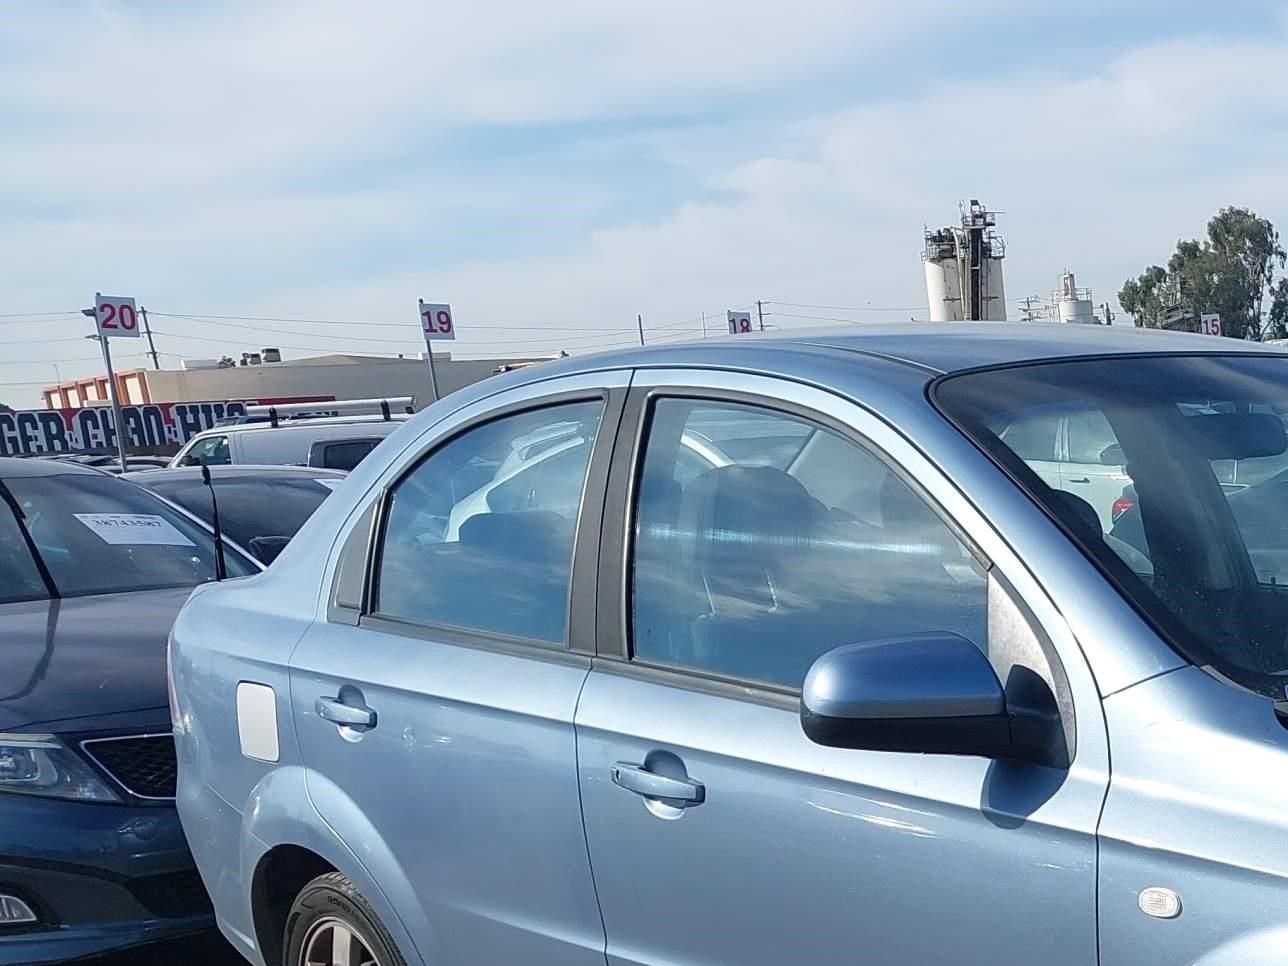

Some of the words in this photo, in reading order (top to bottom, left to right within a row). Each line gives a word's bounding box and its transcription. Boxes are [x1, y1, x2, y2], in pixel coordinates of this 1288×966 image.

[99, 303, 136, 330] 20
[422, 310, 453, 333] 19
[728, 318, 750, 334] 18
[1202, 318, 1219, 335] 15
